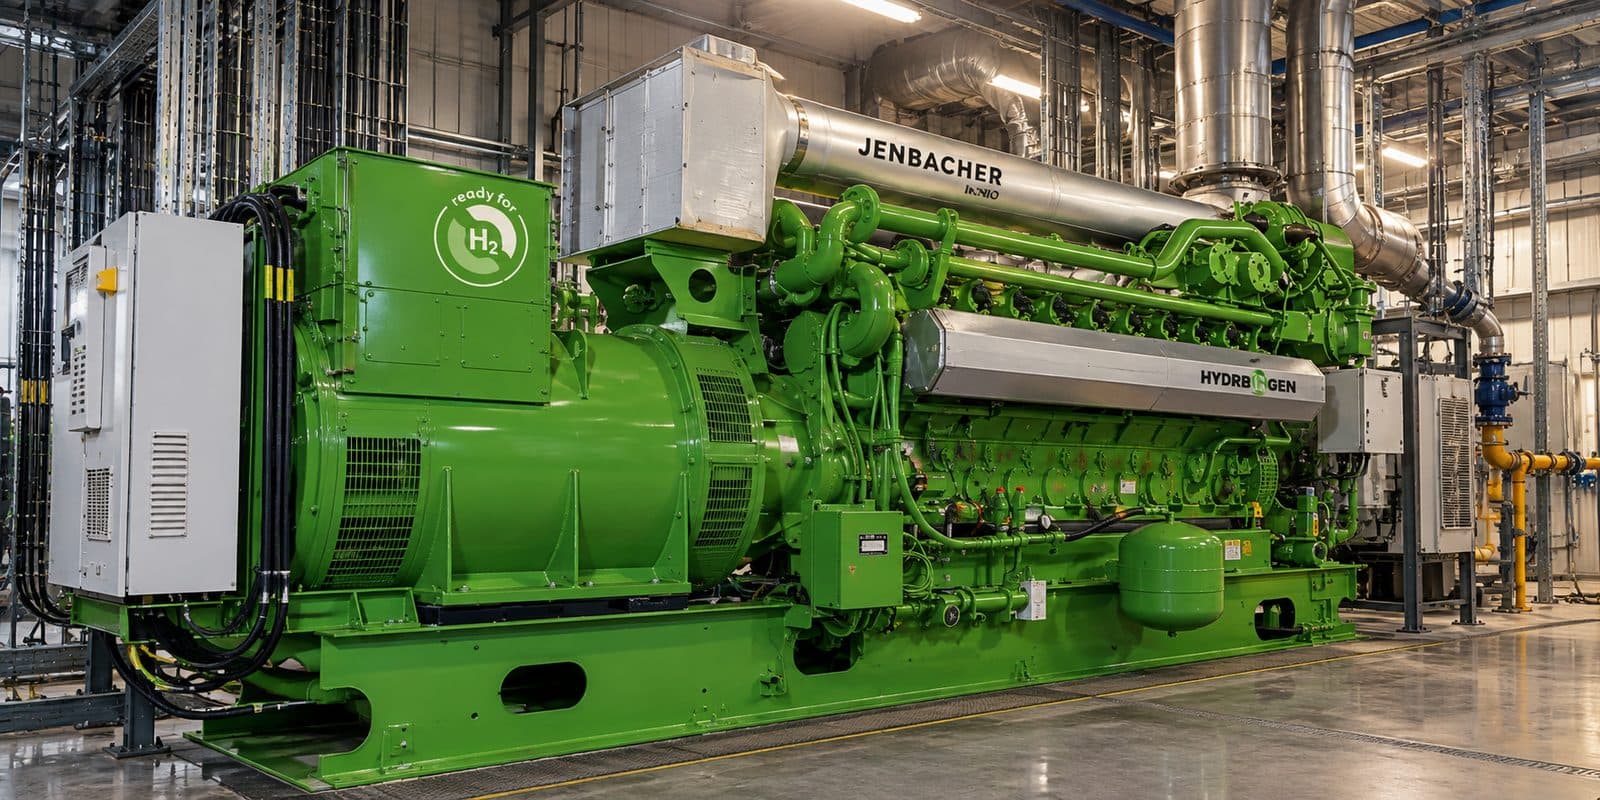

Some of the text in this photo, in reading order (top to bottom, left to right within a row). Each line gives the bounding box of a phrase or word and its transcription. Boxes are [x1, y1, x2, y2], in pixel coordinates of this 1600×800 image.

[858, 137, 1002, 186] JENBACHER
[452, 186, 517, 212] ready for
[469, 228, 498, 255] H2
